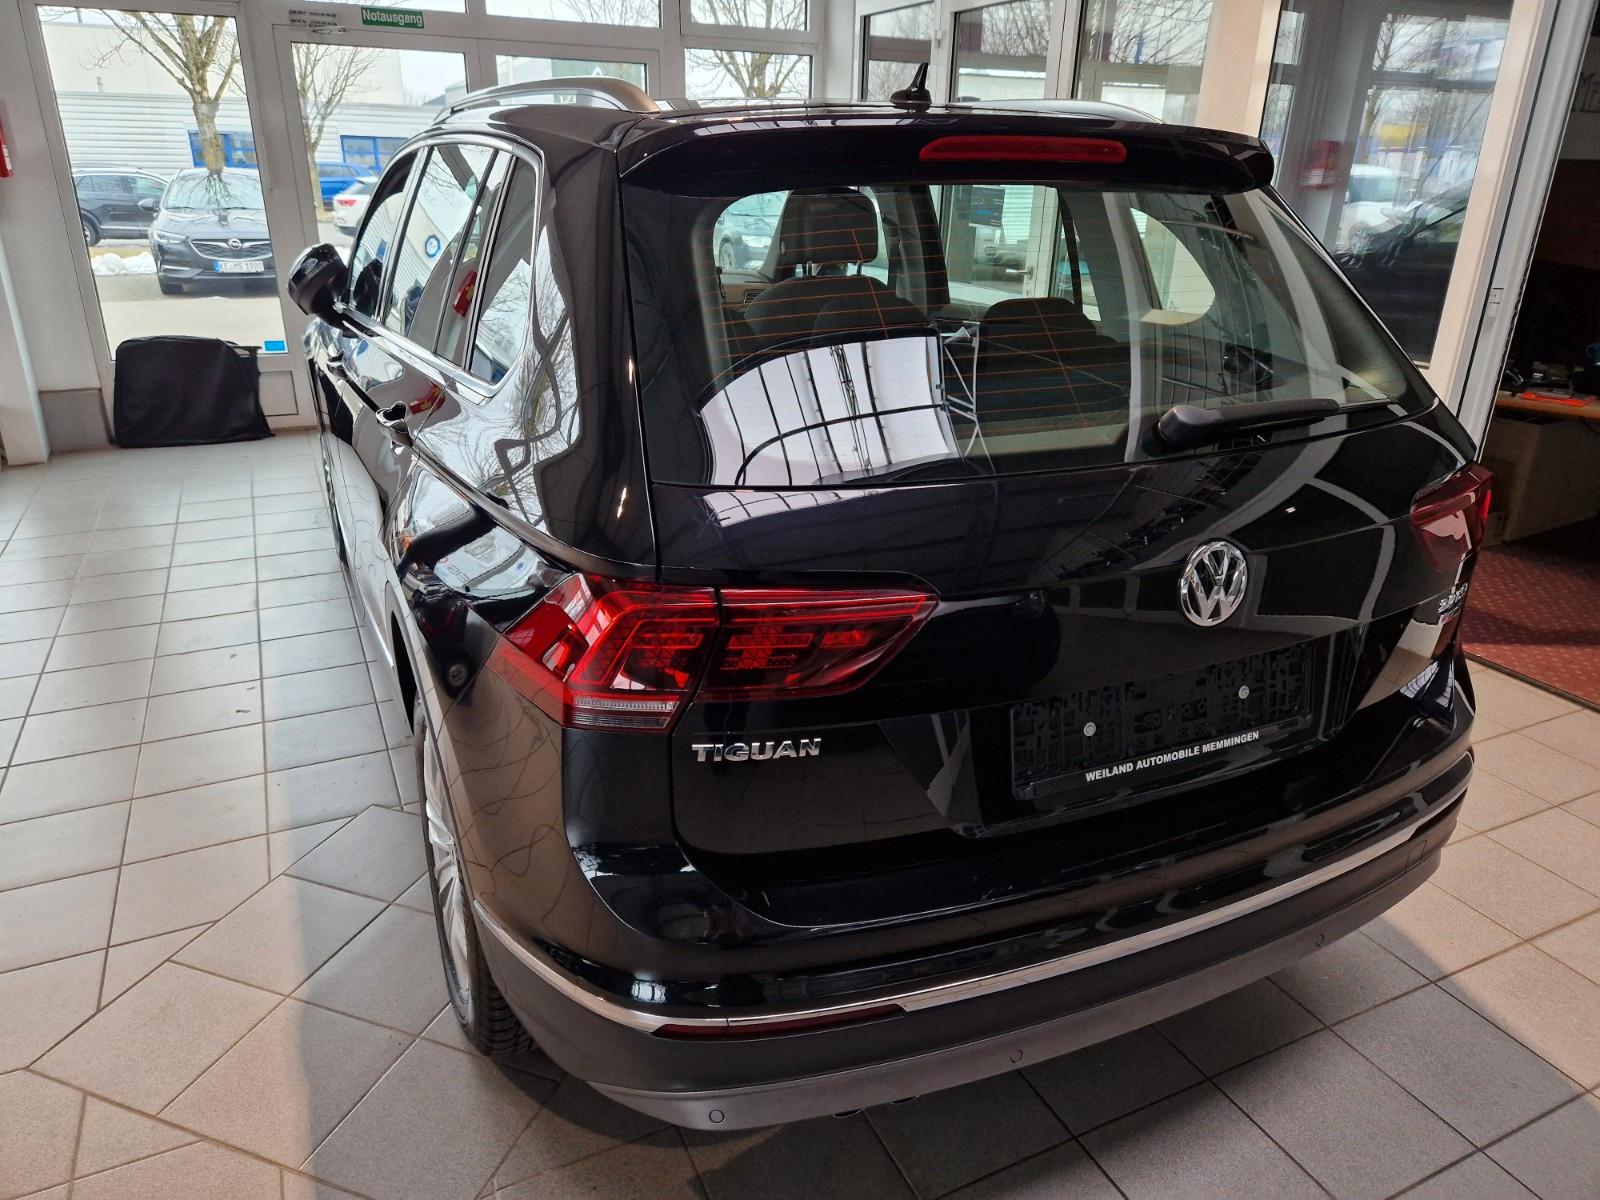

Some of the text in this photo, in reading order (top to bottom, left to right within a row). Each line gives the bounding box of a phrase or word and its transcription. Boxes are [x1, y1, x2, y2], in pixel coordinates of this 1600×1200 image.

[362, 9, 423, 27] Notausgang
[692, 738, 821, 761] TIGUAN
[1085, 730, 1259, 782] WEILAND AUTOMOBILE MEMMINGEN
